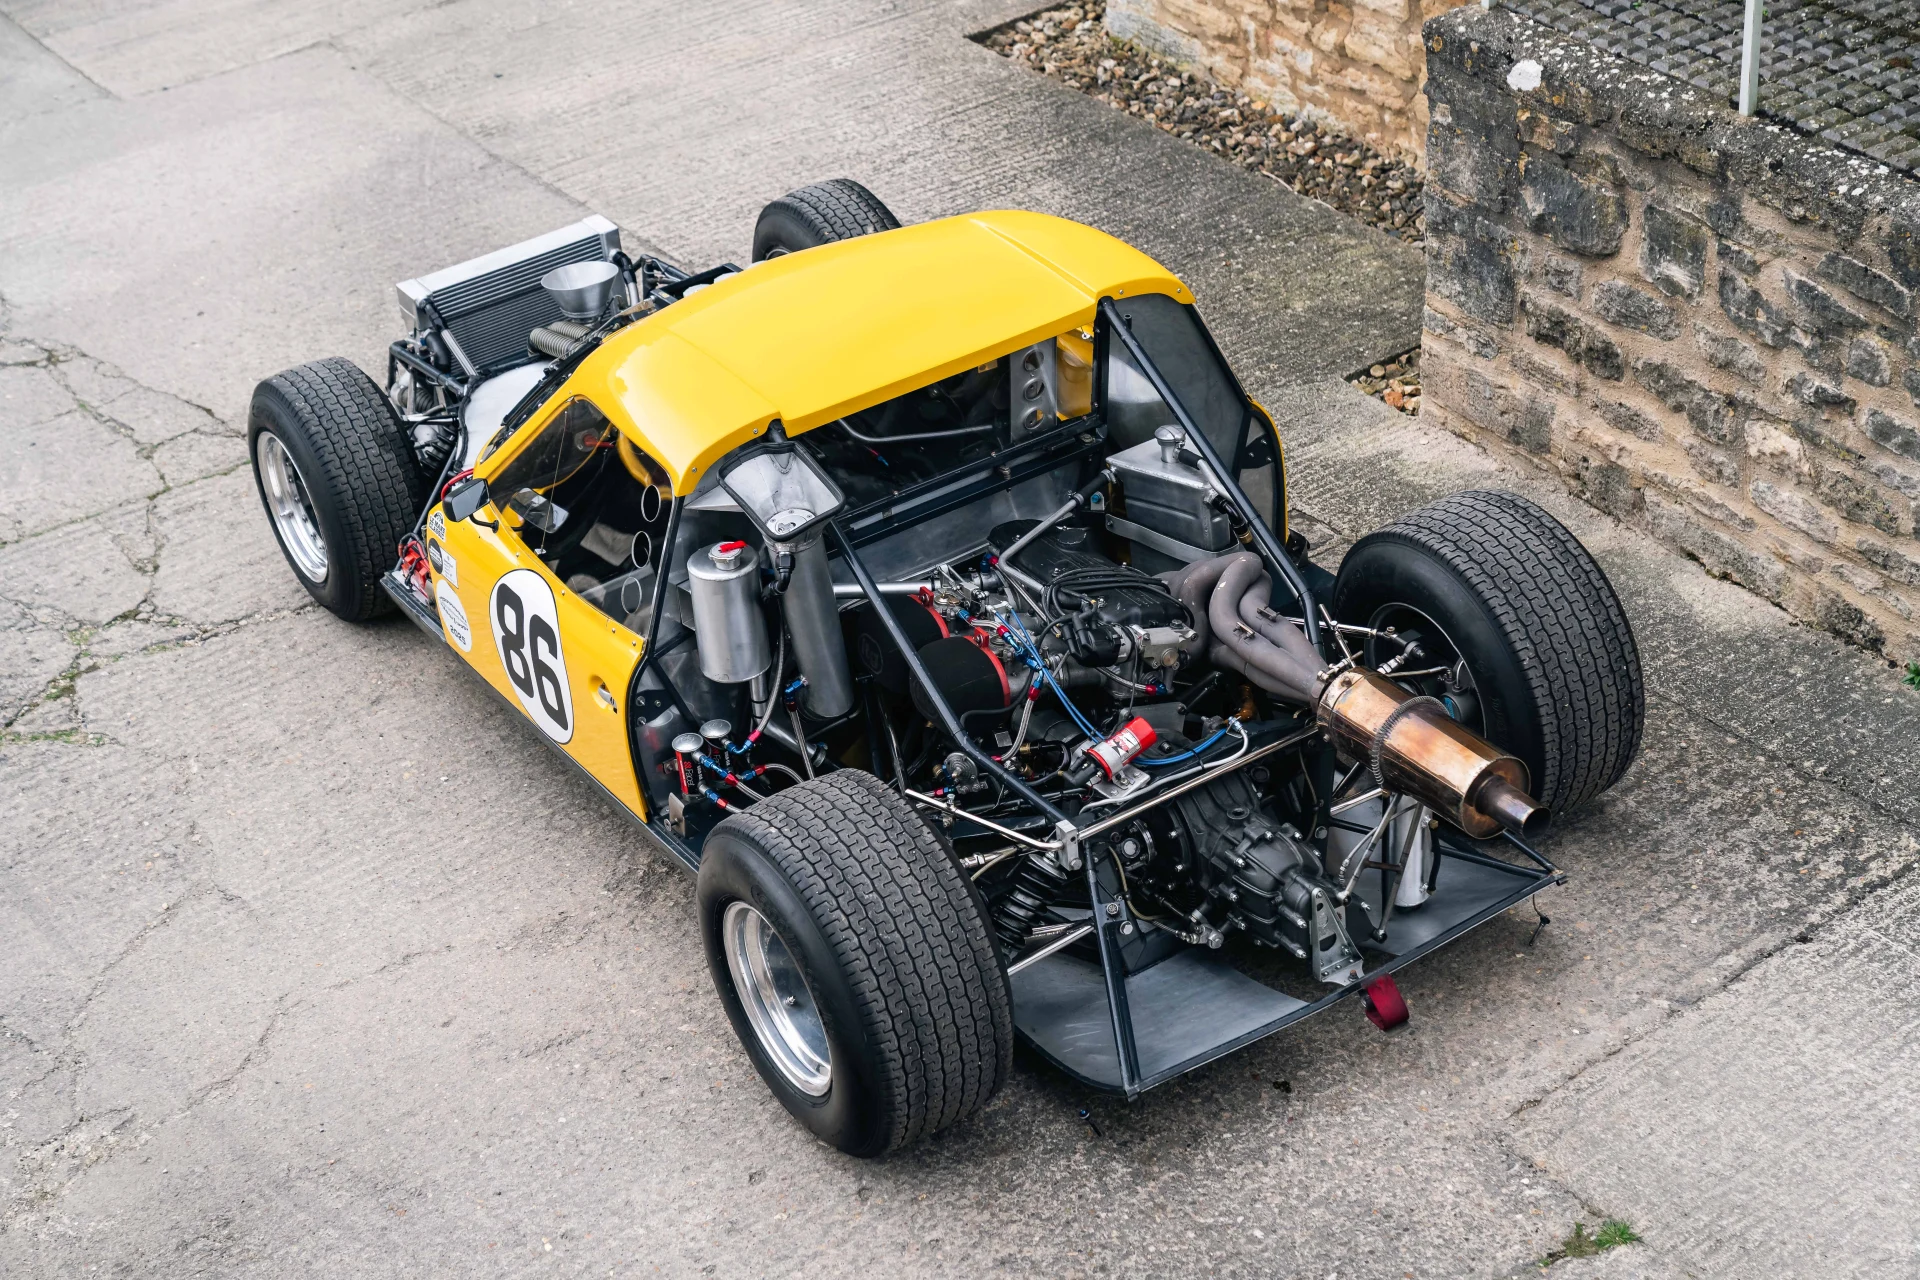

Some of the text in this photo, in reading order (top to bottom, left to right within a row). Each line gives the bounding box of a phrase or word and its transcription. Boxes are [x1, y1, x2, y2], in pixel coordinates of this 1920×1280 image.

[450, 625, 467, 645] 2025
[497, 583, 568, 731] 86
[685, 768, 695, 787] Facet
